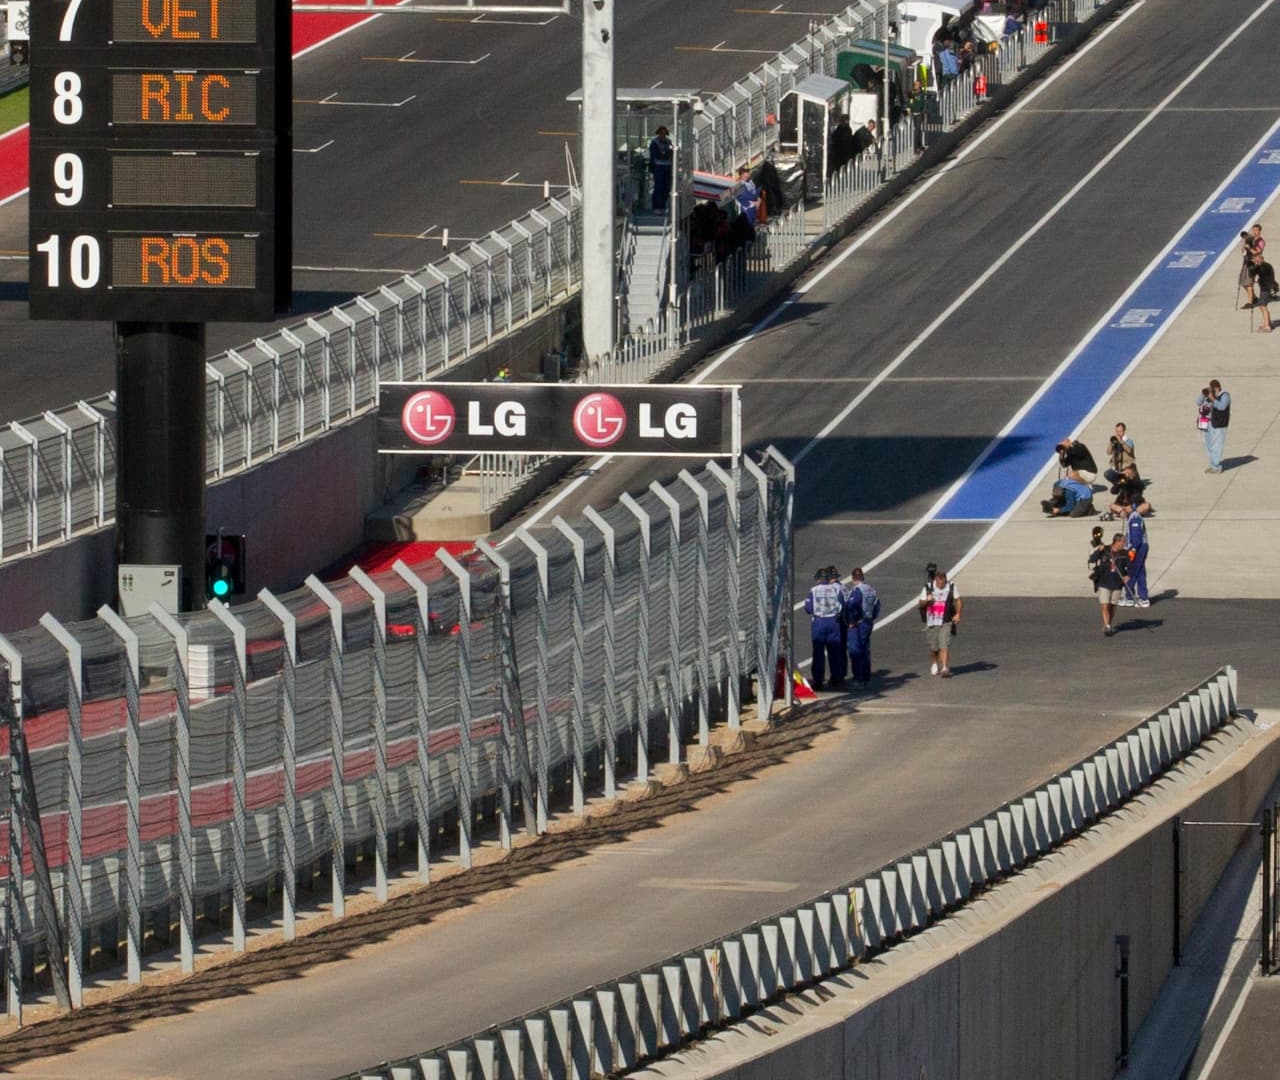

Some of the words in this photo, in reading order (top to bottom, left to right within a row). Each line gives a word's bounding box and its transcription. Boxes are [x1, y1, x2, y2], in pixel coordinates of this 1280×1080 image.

[54, 72, 82, 124] 8
[142, 75, 229, 120] RIC
[54, 153, 83, 205] 9
[37, 235, 99, 288] 10
[142, 238, 229, 284] ROS
[468, 400, 526, 437] LG
[638, 402, 697, 439] LG
